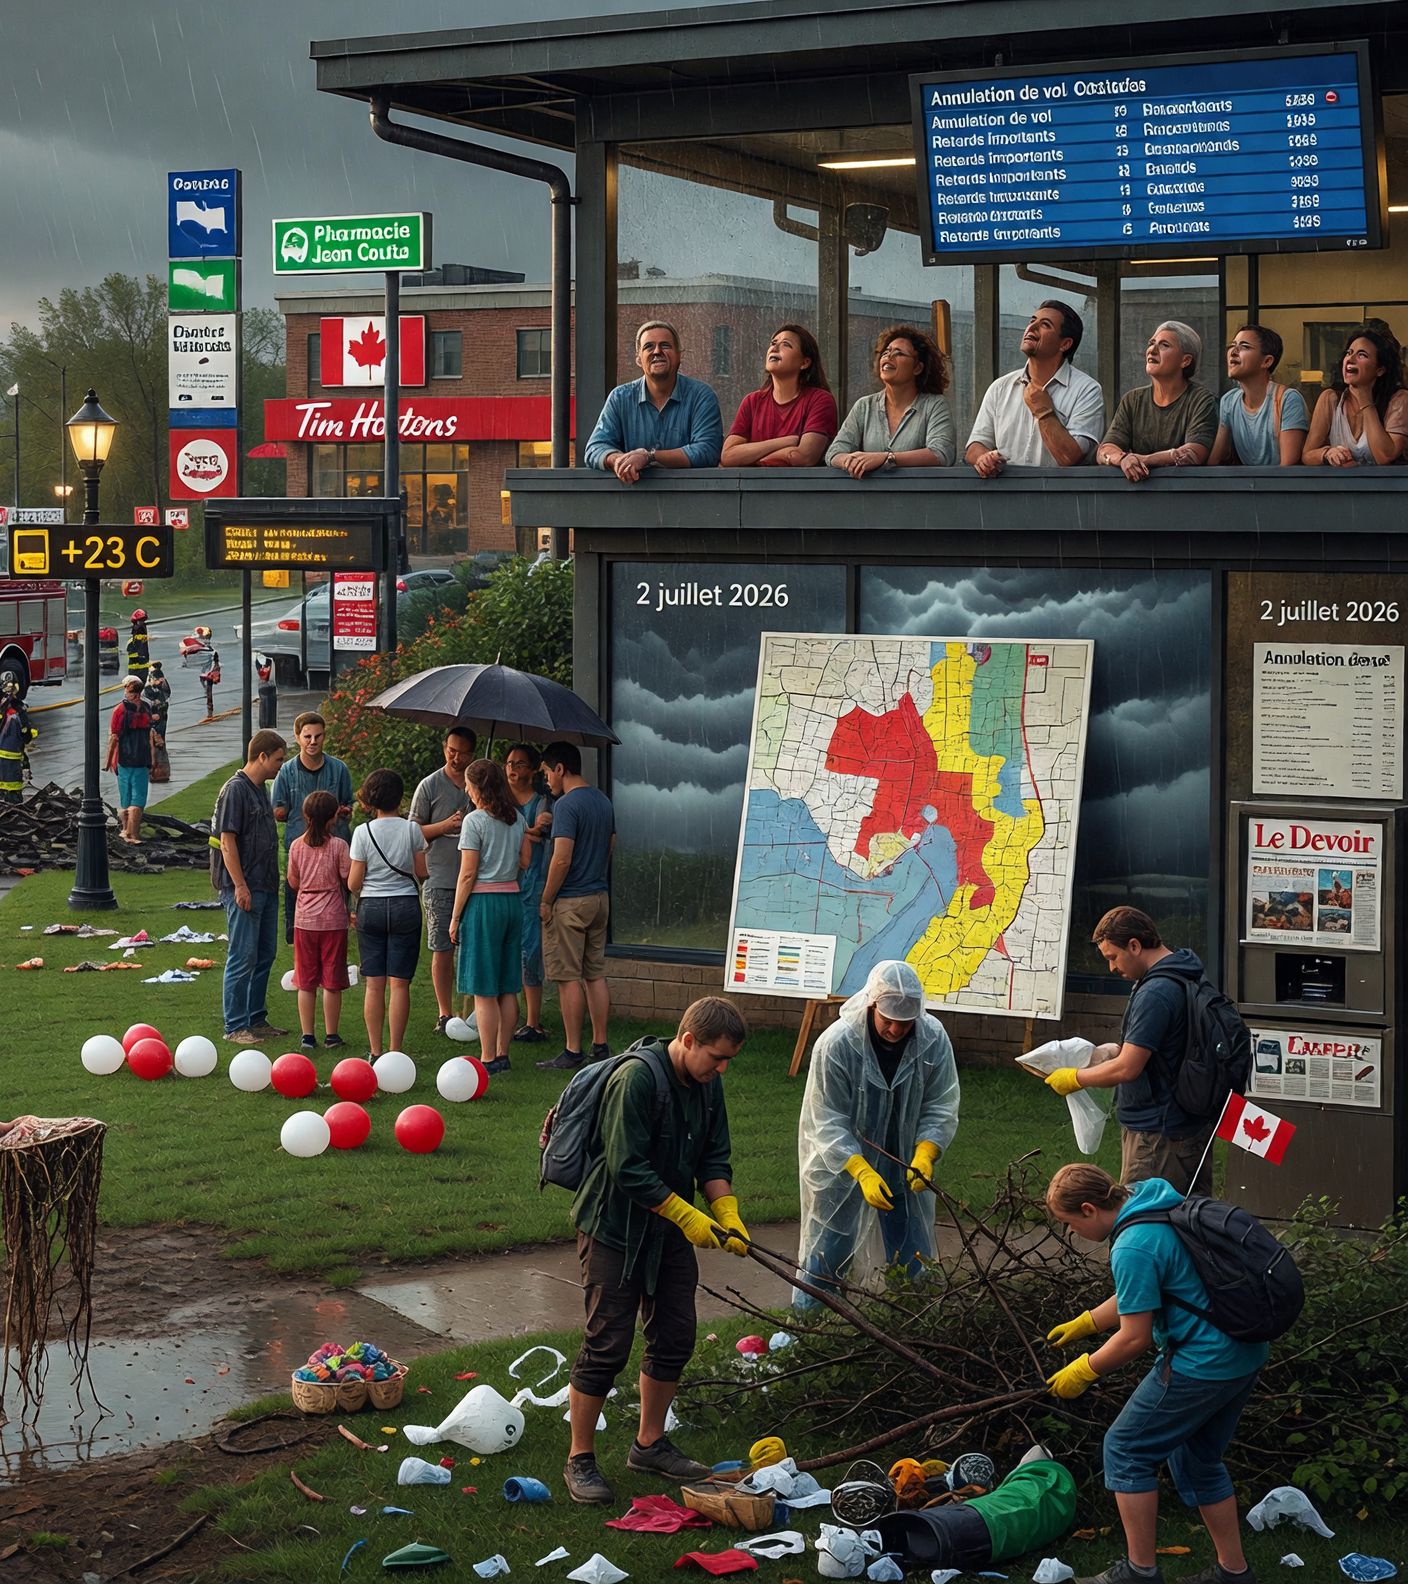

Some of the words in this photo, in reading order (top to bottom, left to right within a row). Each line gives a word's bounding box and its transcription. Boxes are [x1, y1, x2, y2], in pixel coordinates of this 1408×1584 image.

[931, 86, 1015, 106] Annulation
[1020, 85, 1039, 100] de
[1043, 82, 1068, 98] vol
[1031, 109, 1052, 123] vol
[314, 221, 411, 242] Pharmacie
[295, 402, 344, 438] Tim
[350, 400, 458, 437] Hotons
[61, 535, 126, 569] +23
[135, 535, 161, 568] C
[636, 582, 650, 605] 2
[655, 582, 723, 612] juillet
[728, 583, 789, 607] 2026
[1260, 600, 1274, 620] 2
[1277, 599, 1340, 626] juillet
[1346, 601, 1400, 622] 2026
[1254, 823, 1285, 849] Le
[1289, 824, 1375, 853] Devoir
